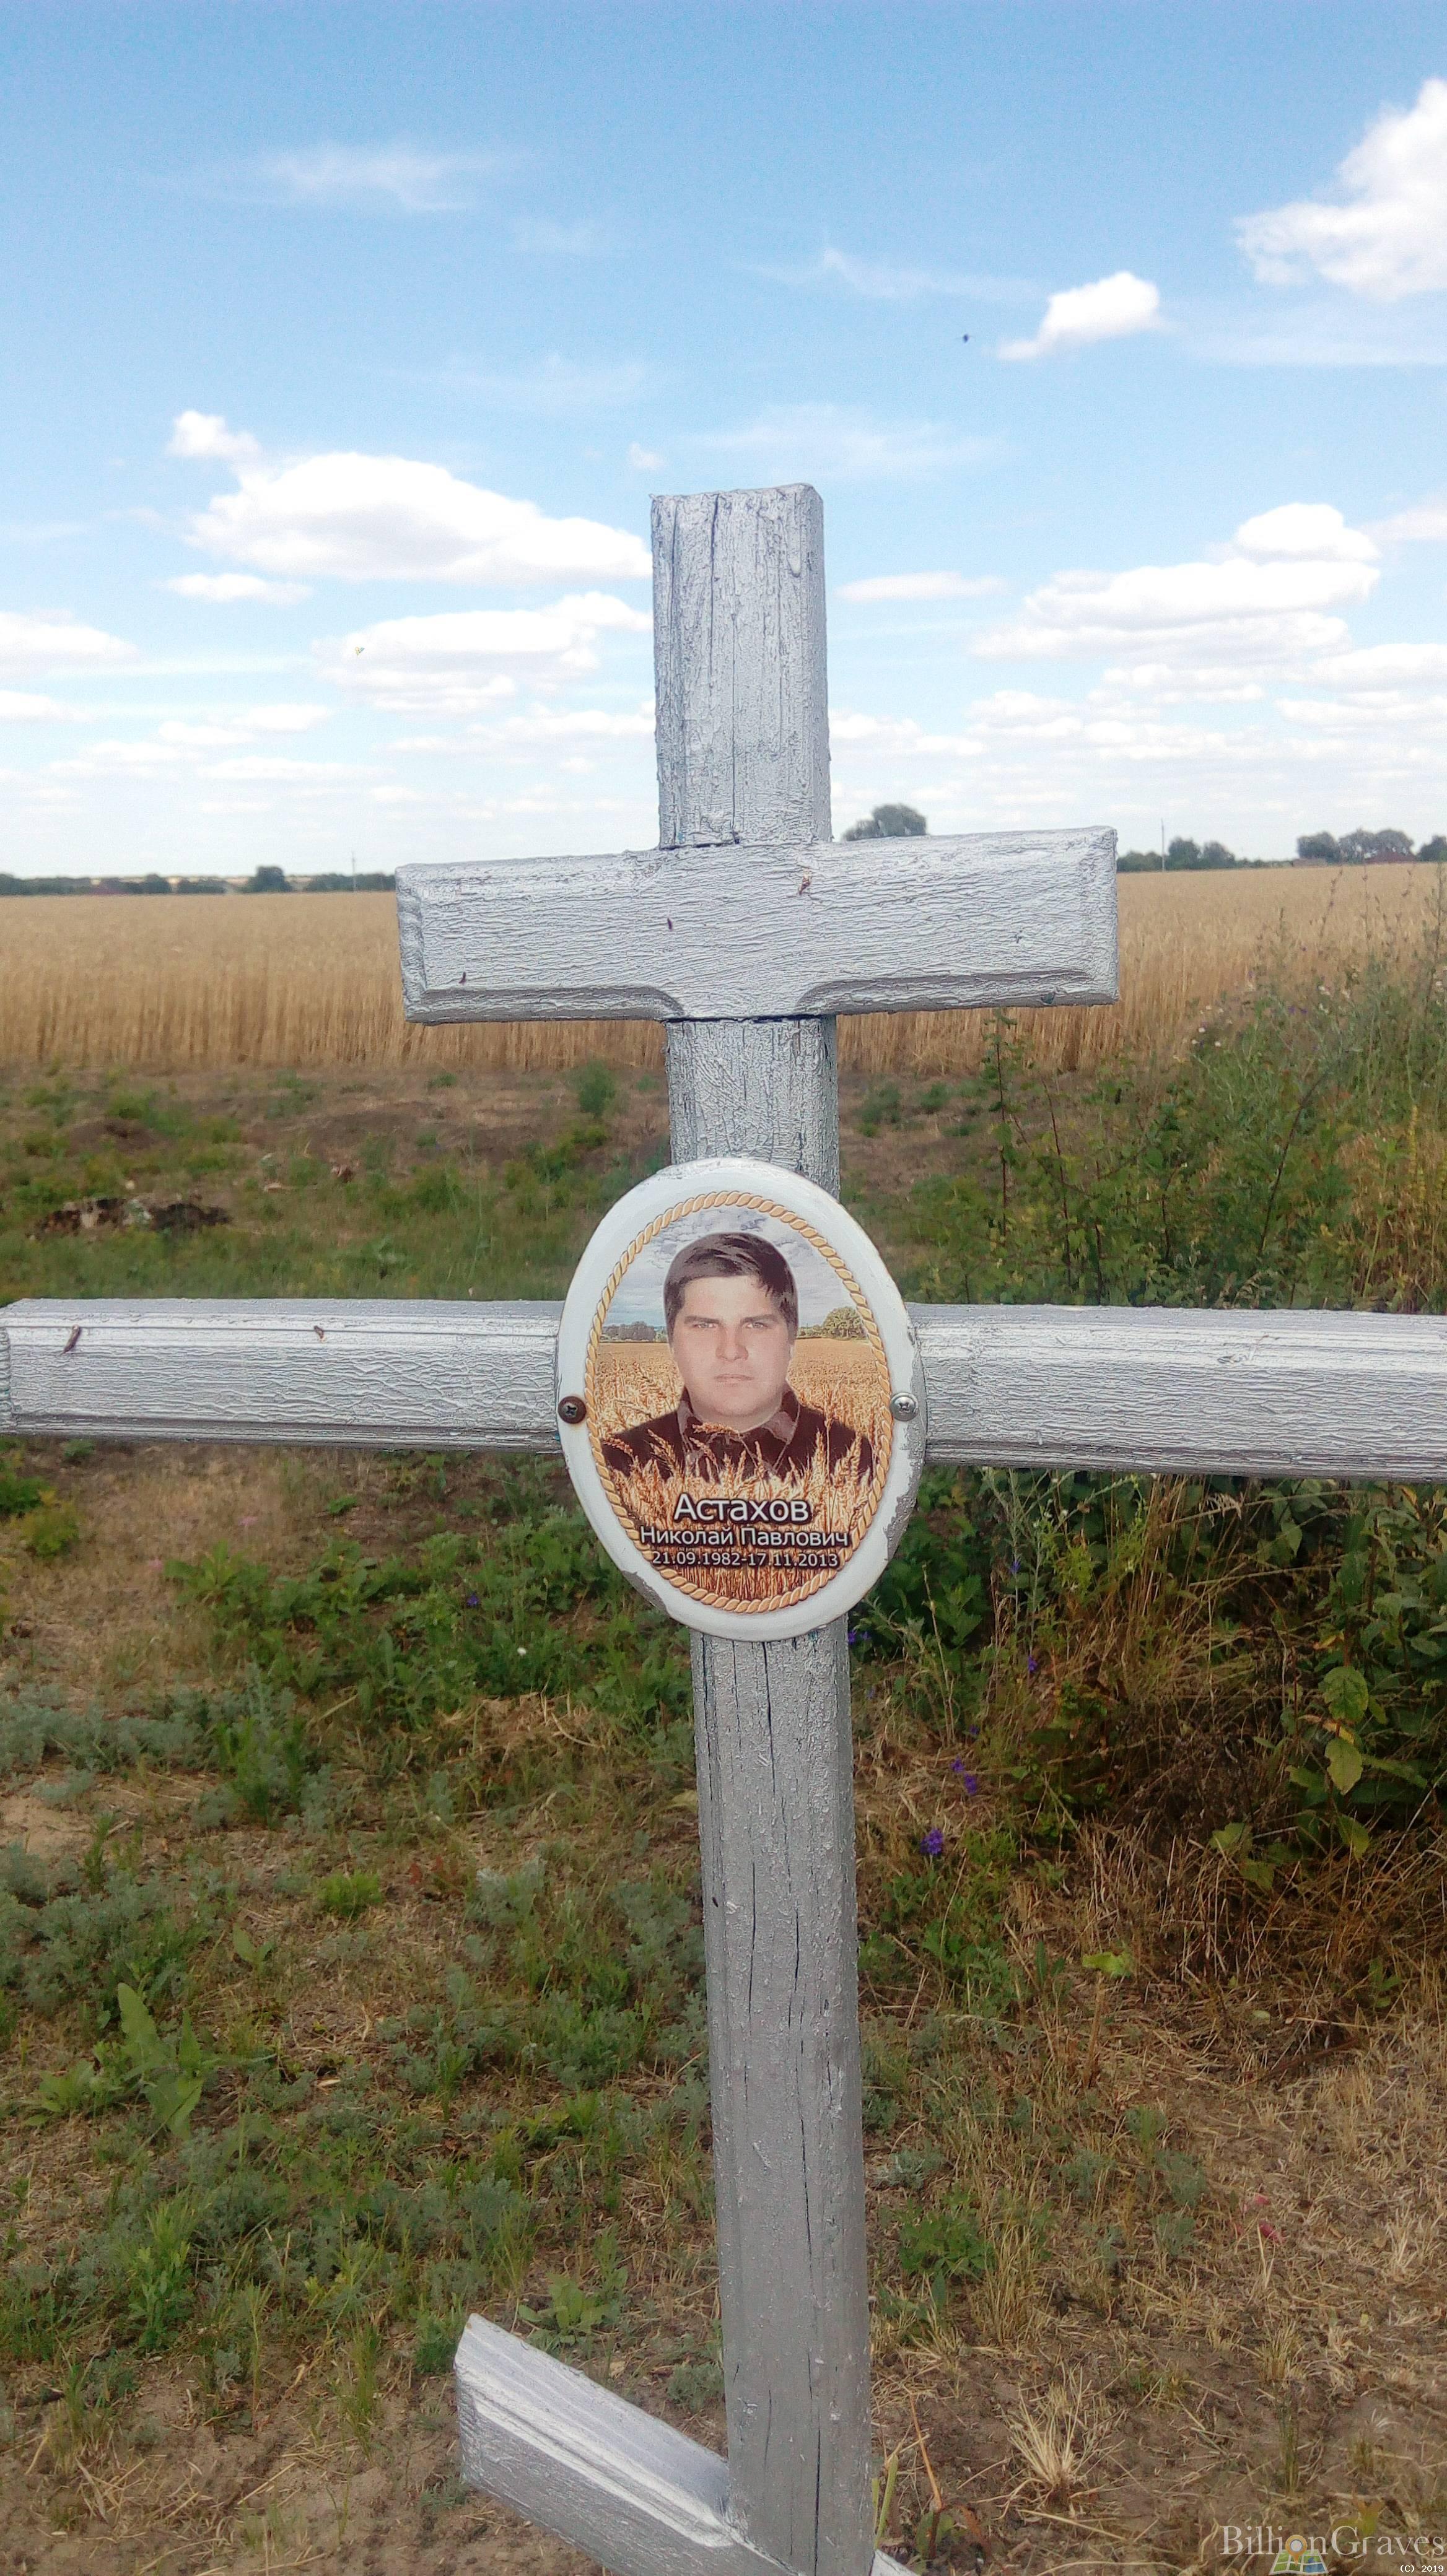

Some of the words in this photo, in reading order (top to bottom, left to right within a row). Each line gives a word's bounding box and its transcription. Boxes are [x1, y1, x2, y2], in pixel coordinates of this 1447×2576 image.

[673, 1493, 809, 1521] Астахов
[640, 1525, 733, 1546] Николай
[741, 1527, 849, 1547] Павлович
